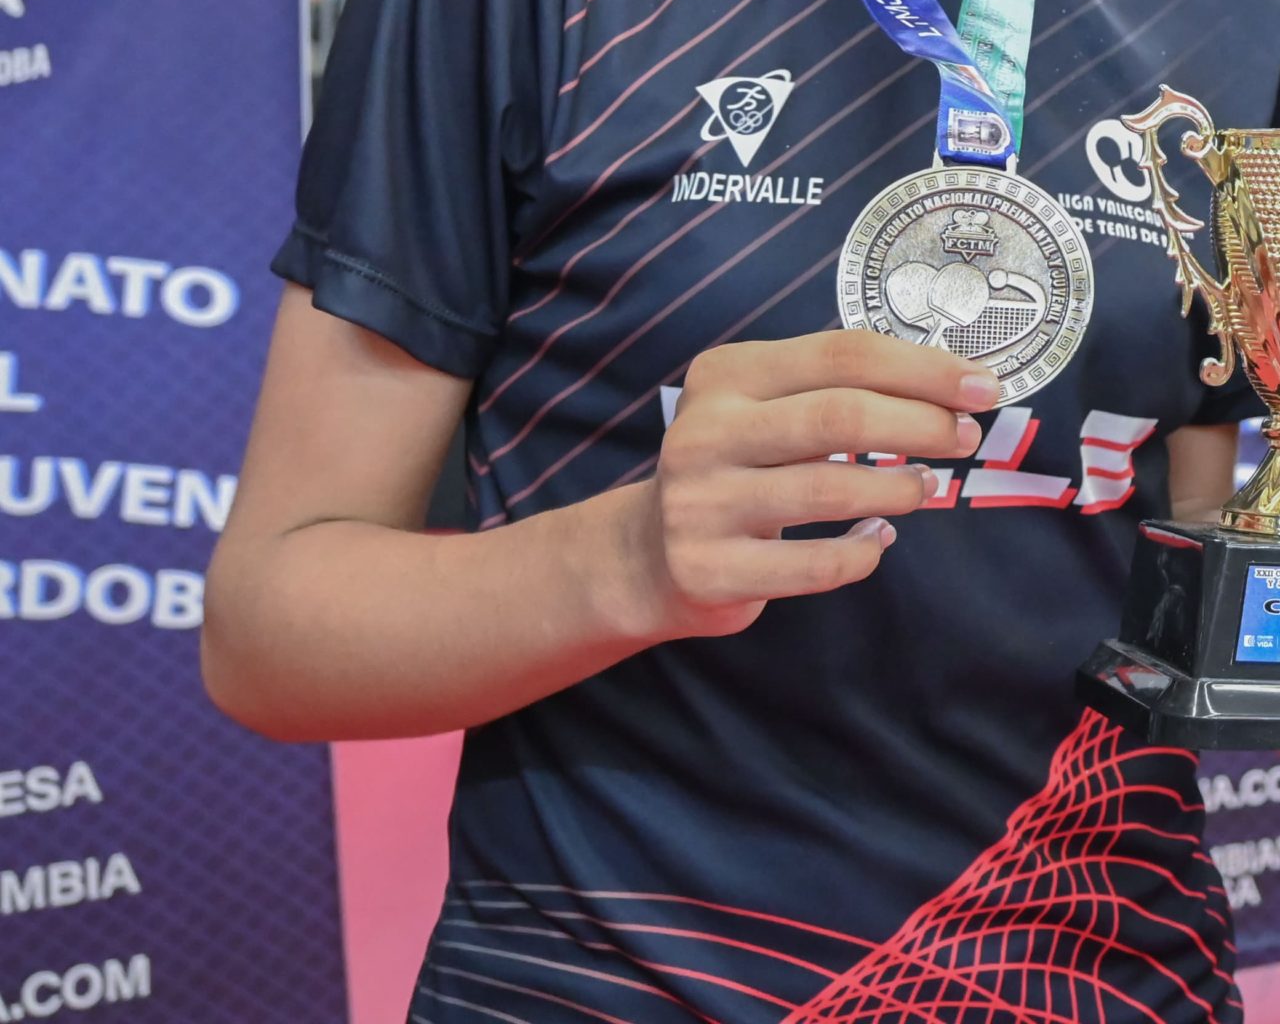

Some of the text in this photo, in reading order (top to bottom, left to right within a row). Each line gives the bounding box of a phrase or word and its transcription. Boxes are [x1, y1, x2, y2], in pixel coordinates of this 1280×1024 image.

[671, 171, 825, 205] INDERVALLE
[947, 238, 993, 251] FCTM
[1096, 219, 1139, 241] TENIS
[865, 202, 926, 278] CAMPEONATO
[922, 191, 990, 213] NACIONAL
[990, 197, 1057, 260] PREINFANTIL
[1045, 269, 1069, 325] JUVENIL
[0, 247, 241, 328] NATO
[1256, 569, 1274, 578] XXII
[0, 760, 103, 818] ESA
[0, 852, 142, 915] MBIA
